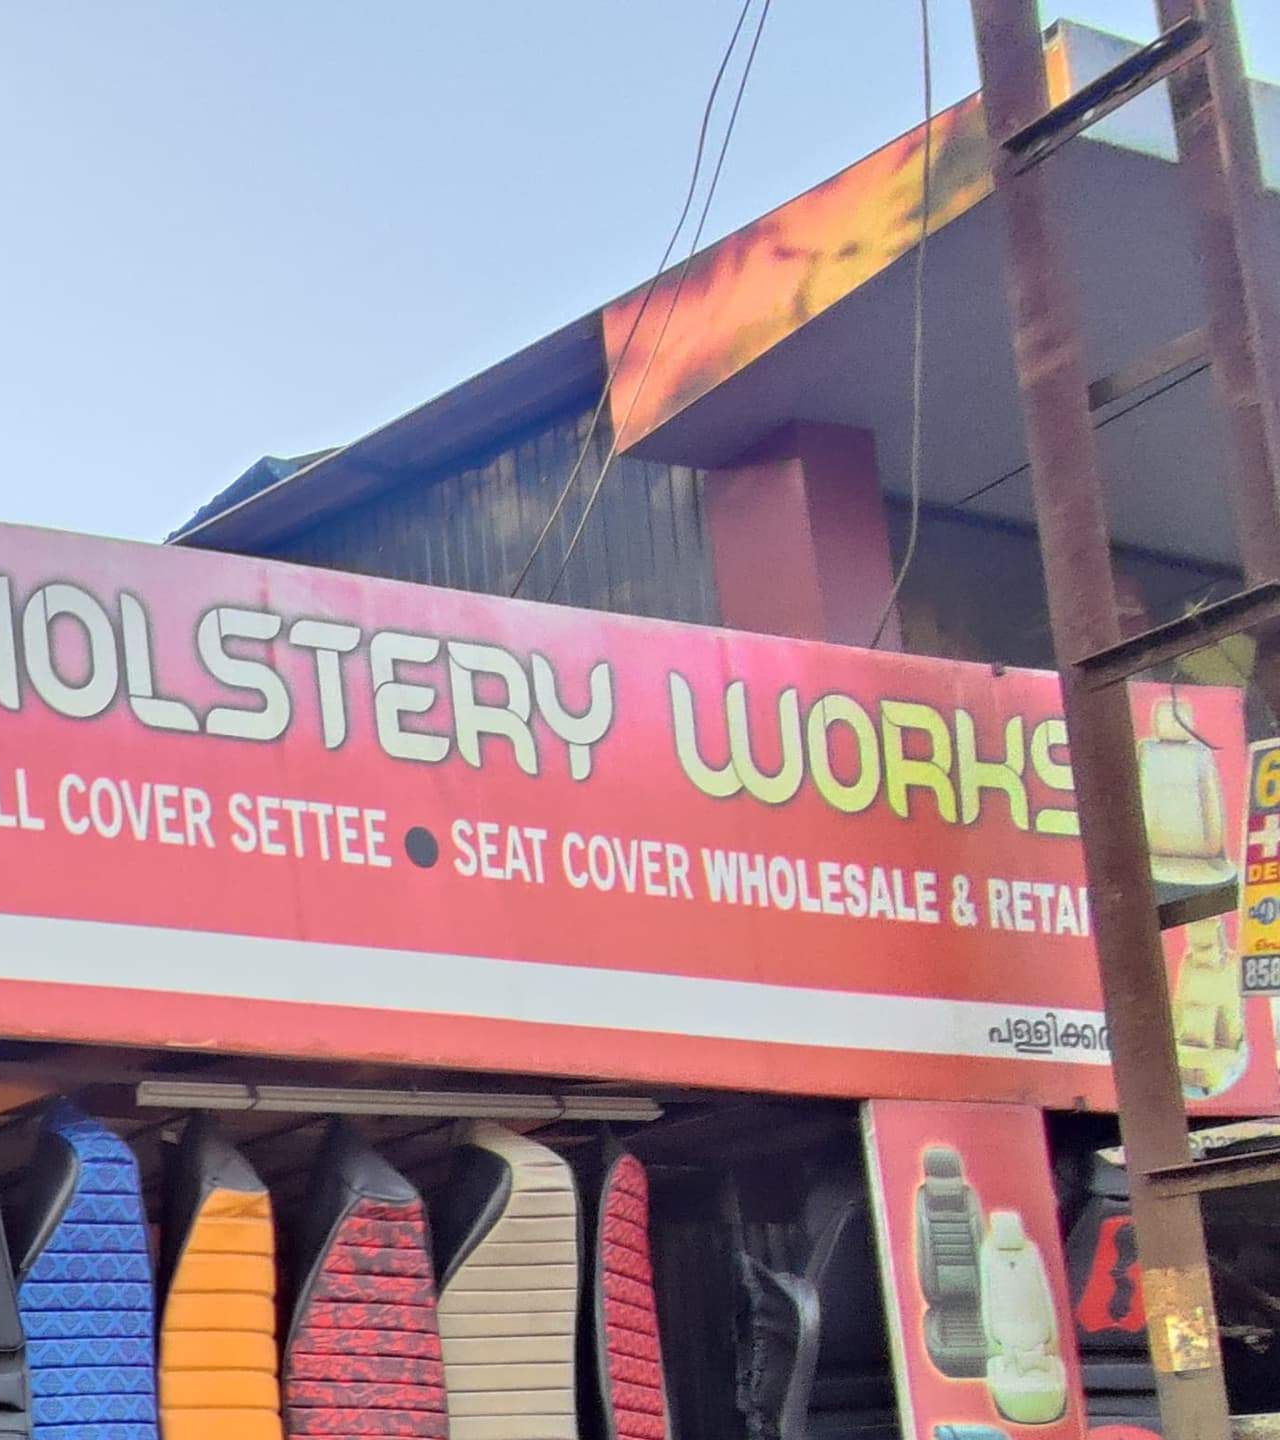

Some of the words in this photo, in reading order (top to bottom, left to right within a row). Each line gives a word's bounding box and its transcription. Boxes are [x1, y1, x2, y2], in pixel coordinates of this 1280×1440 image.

[59, 773, 215, 848] COVER
[228, 793, 393, 867] SETTEE
[452, 819, 547, 883] SEAT
[562, 832, 694, 899] COVER
[702, 848, 941, 923] WHOLESALE
[950, 874, 979, 927] &
[988, 879, 1091, 937] RETAI
